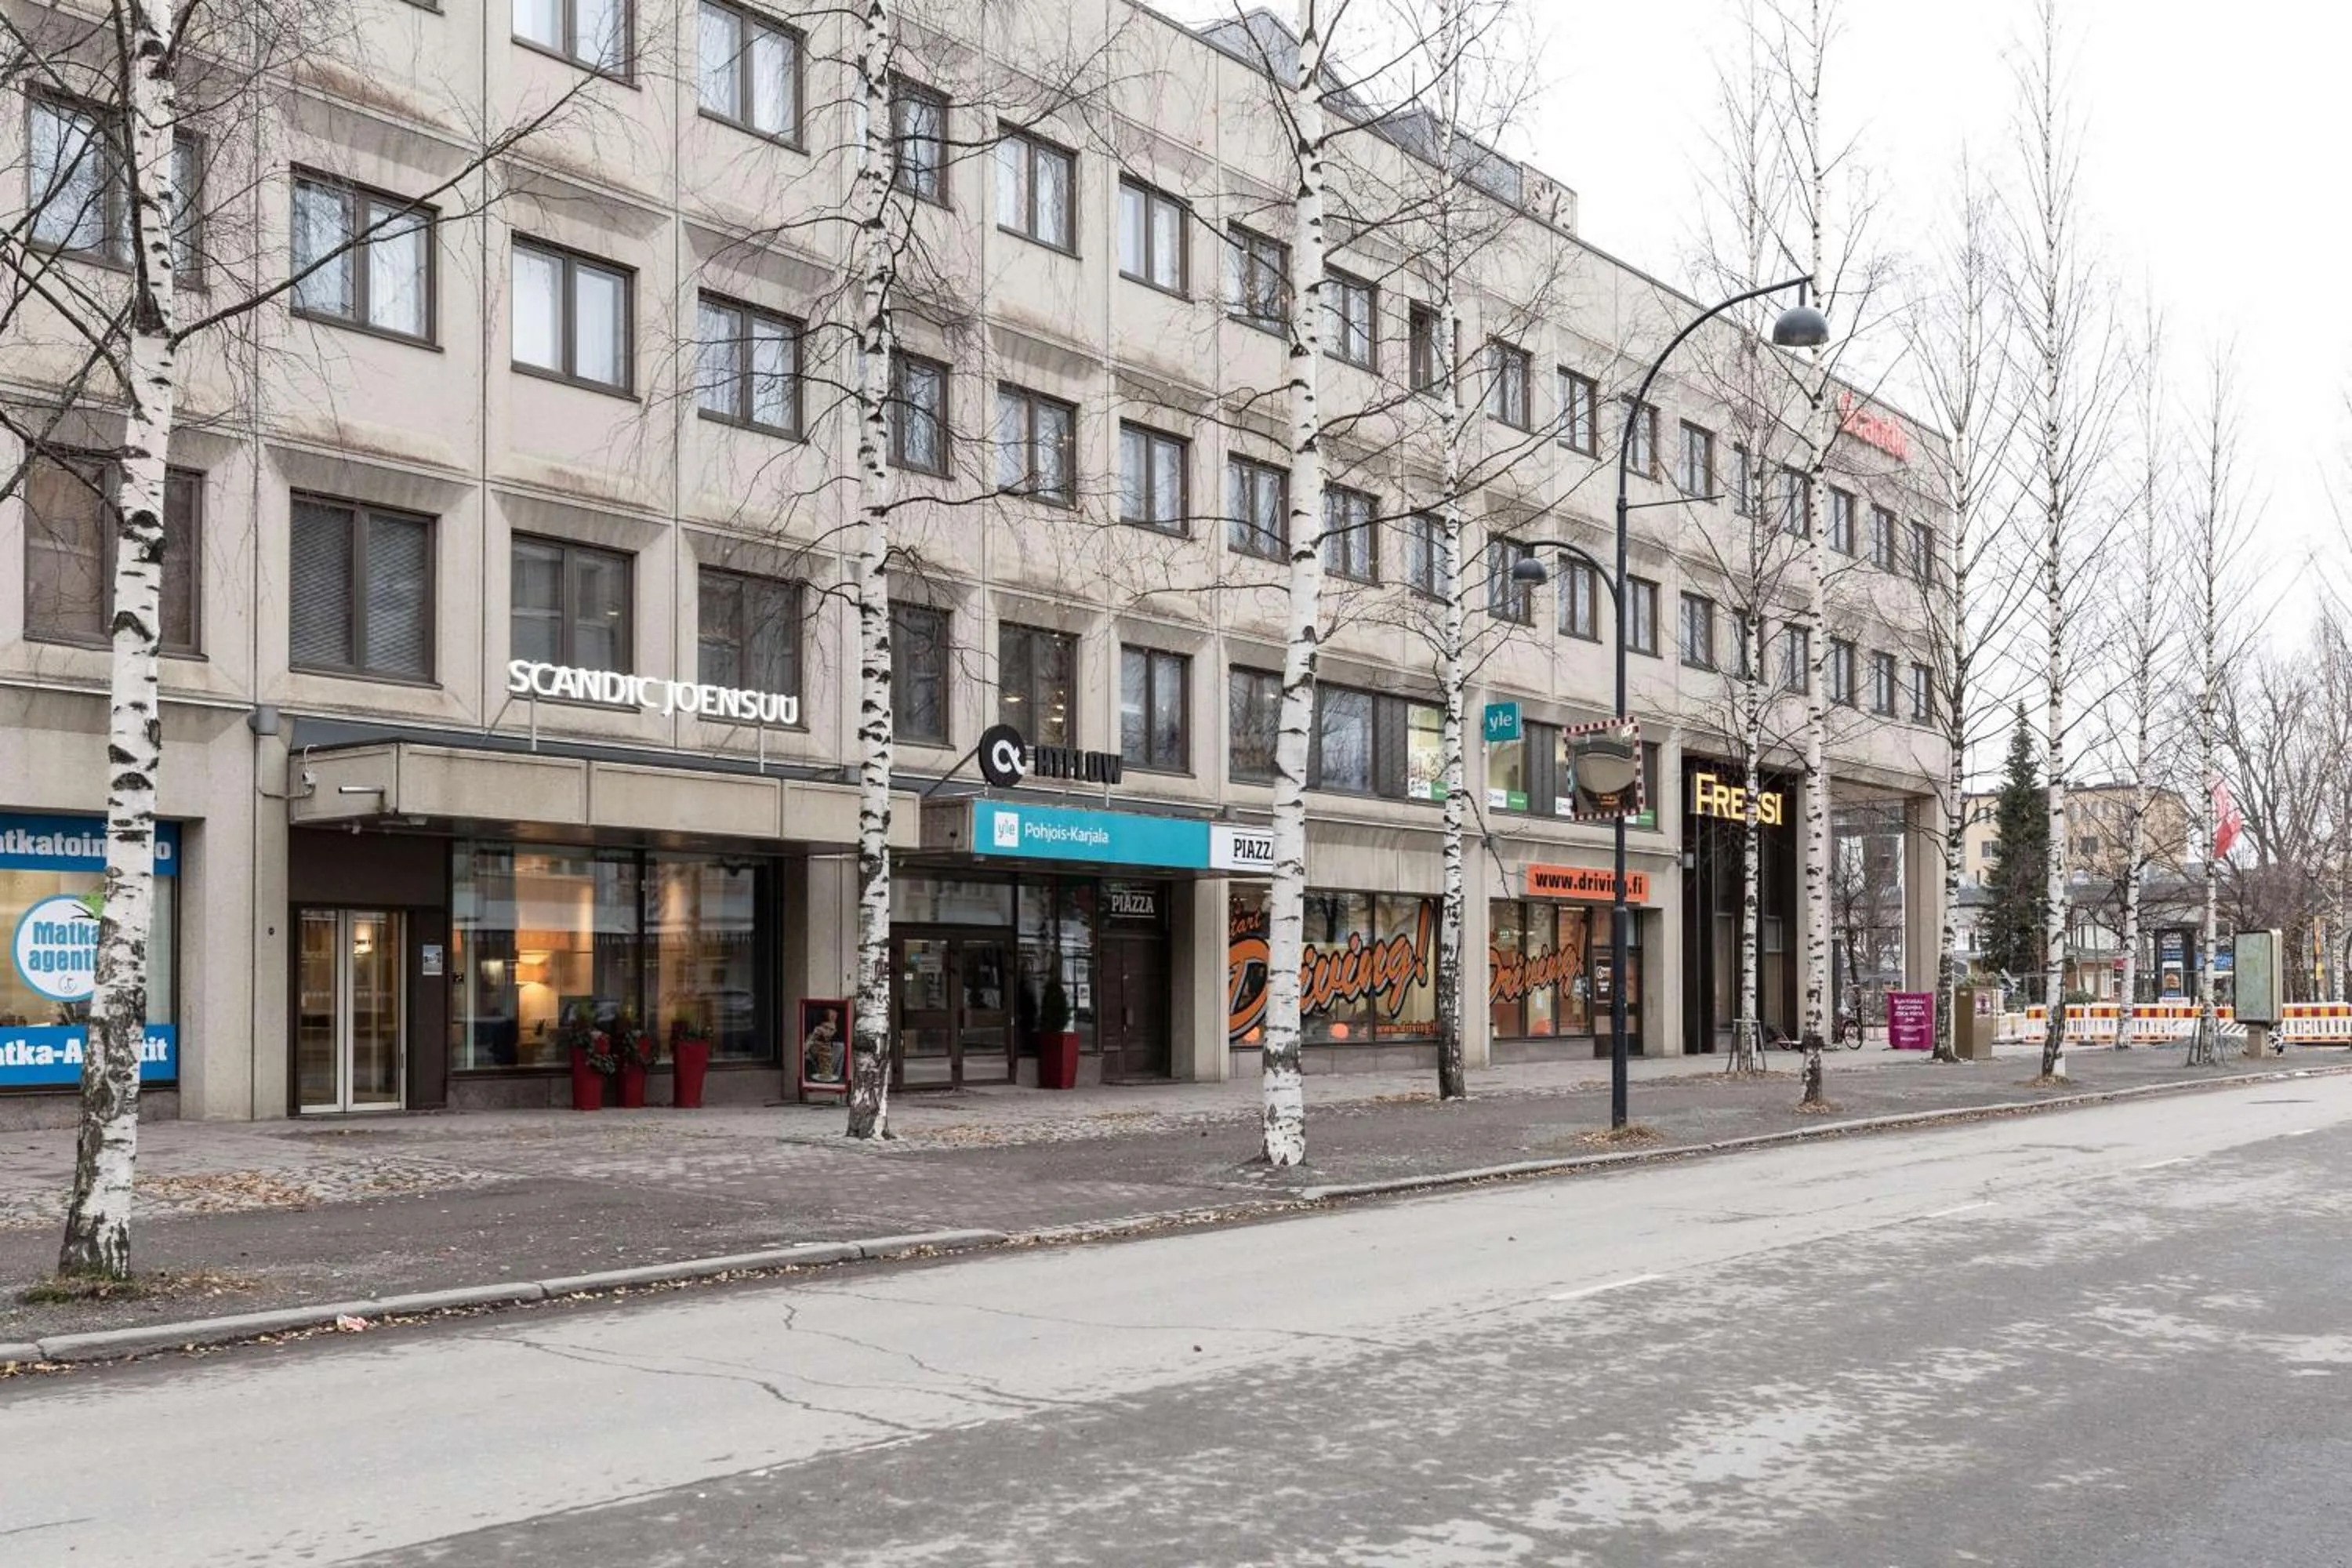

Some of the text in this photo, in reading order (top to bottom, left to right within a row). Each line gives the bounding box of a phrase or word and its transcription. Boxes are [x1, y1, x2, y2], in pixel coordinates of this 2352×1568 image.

[507, 659, 798, 724] SCANDIC JOENSUU
[1490, 710, 1513, 732] yle
[998, 819, 1016, 838] yle
[1024, 821, 1110, 847] Pohjois-Karjala
[1233, 838, 1274, 861] PIAZZ
[1535, 871, 1643, 897] www.drivi.fi
[1111, 894, 1155, 914] PIAZZA
[32, 921, 101, 946] Matka
[28, 948, 99, 973] agenti
[1229, 897, 1432, 1041] Diving!
